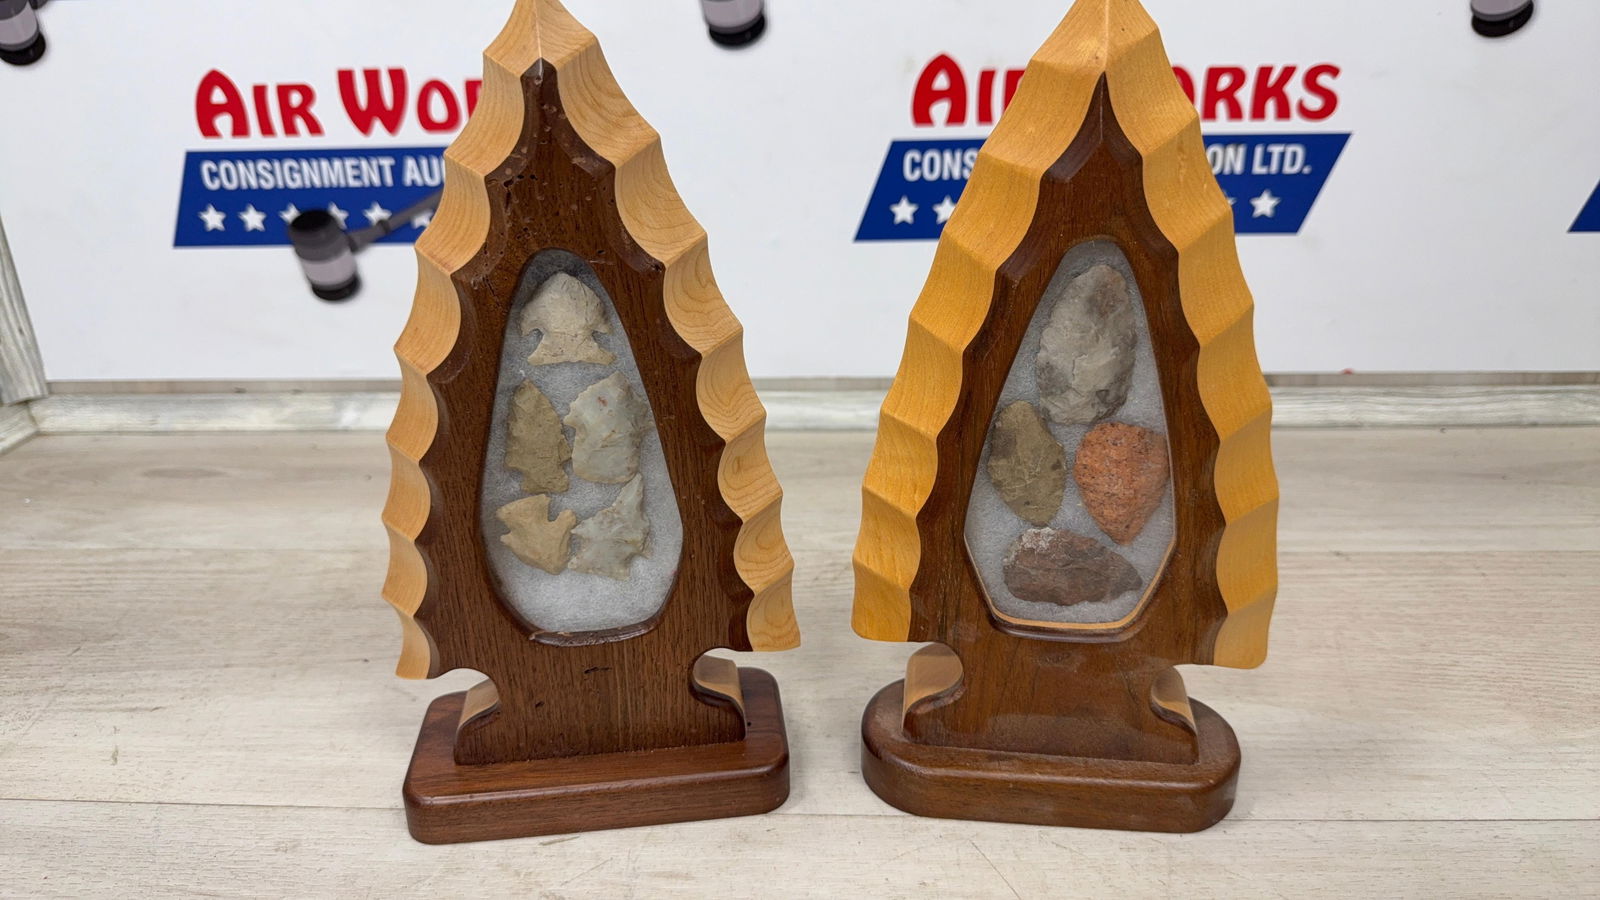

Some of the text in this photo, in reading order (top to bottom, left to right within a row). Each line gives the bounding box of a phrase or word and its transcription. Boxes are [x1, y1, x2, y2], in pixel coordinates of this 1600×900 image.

[195, 69, 324, 138] AIR
[202, 154, 446, 191] CONSIGNMENT AU
[1251, 143, 1312, 175] LTD.
